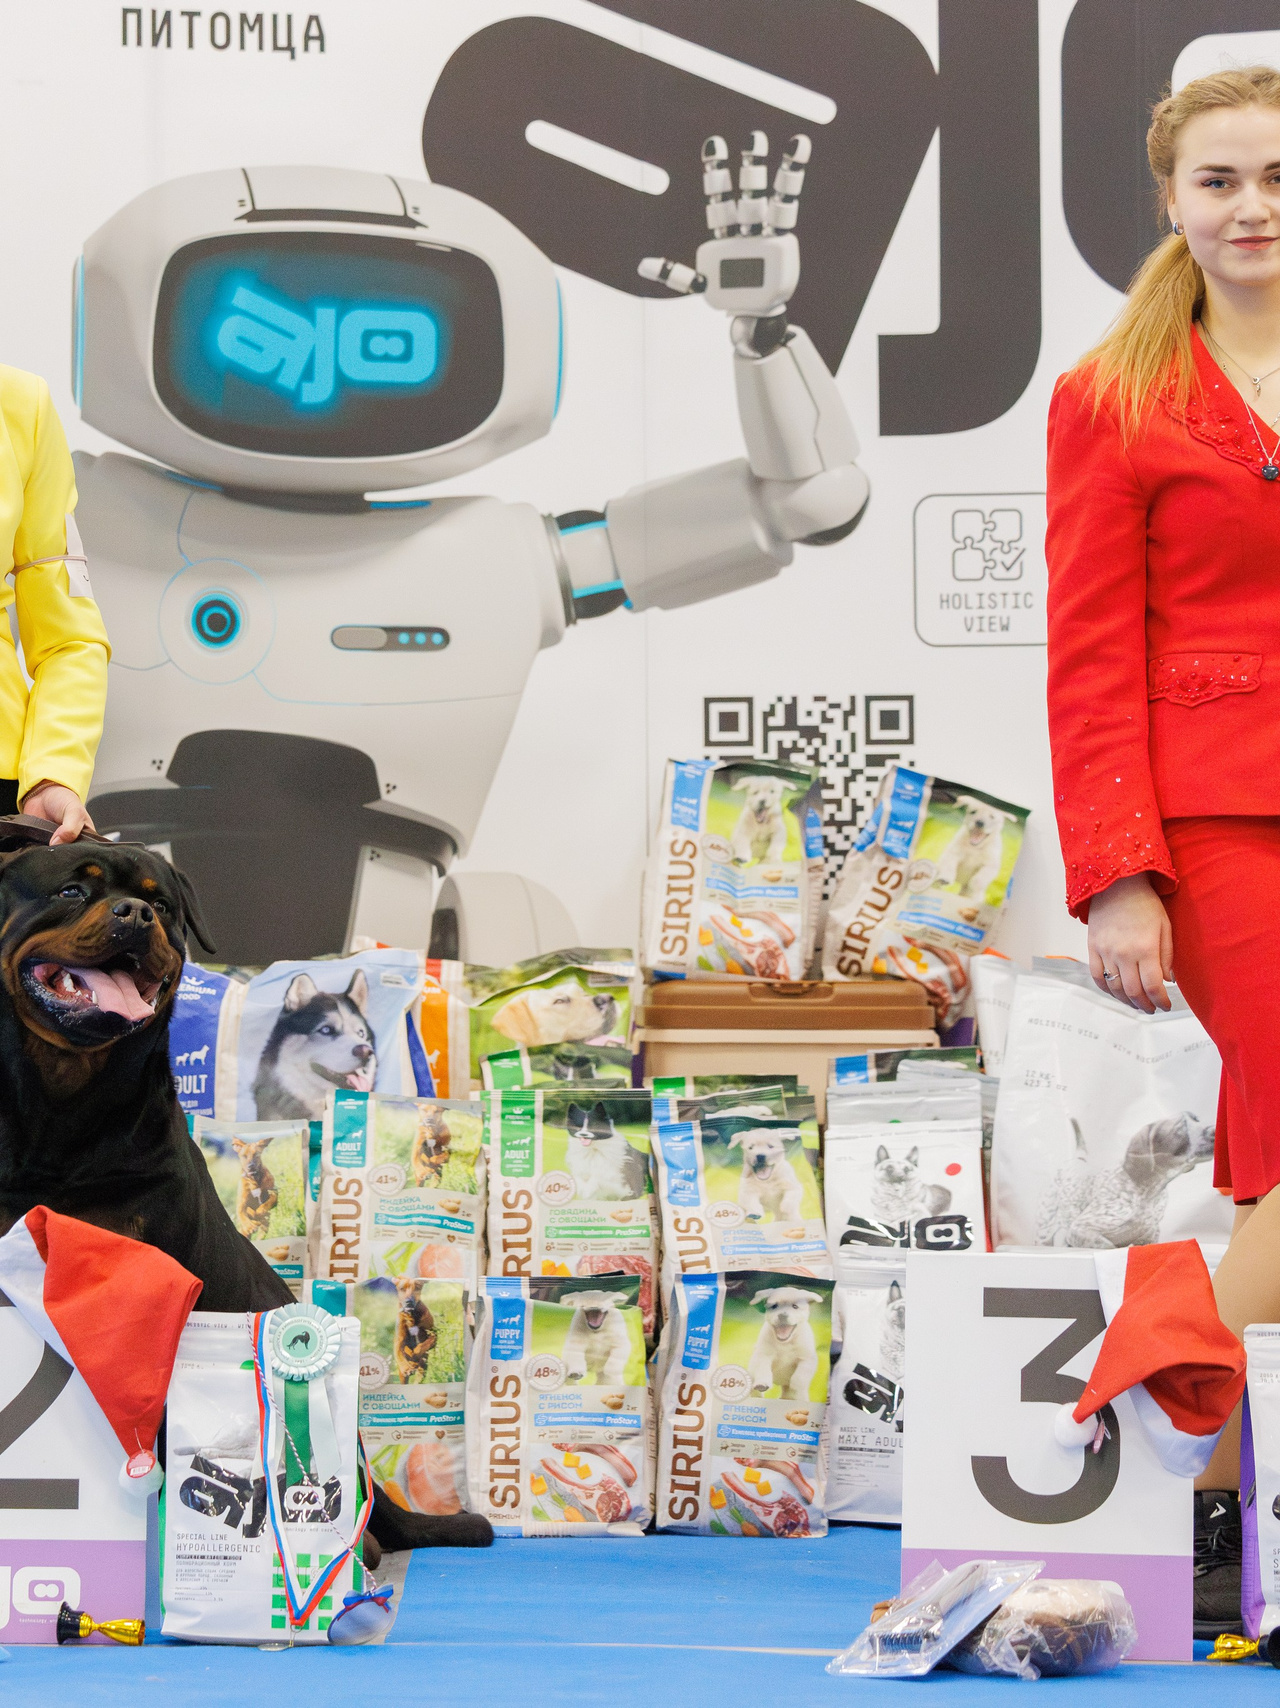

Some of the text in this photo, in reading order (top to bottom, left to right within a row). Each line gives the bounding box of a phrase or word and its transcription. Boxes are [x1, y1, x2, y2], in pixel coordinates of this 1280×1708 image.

[121, 7, 326, 60] ПИТОМЦА
[939, 592, 1034, 610] HOLISTIC
[964, 616, 1010, 633] VIEW
[659, 838, 698, 957] SIRIUS
[835, 866, 904, 977] SIRIUS
[1027, 1016, 1072, 1032] HOLISTIC
[335, 1142, 362, 1152] ADULT
[504, 1149, 530, 1160] ADULT
[376, 1174, 398, 1184] 41%
[545, 1182, 570, 1194] 40%
[549, 1208, 598, 1216] ГОВЯДИНА
[714, 1209, 739, 1218] 48%
[558, 1216, 607, 1224] ОВОЩАМИ
[329, 1176, 363, 1283] IRIUS
[494, 1328, 521, 1340] PUPPY
[687, 1336, 709, 1349] PUPPY
[534, 1366, 560, 1378] 48%
[719, 1377, 745, 1389] 48%
[362, 1392, 406, 1402] ИНДЕЙКА
[538, 1393, 583, 1401] ЯГНЕНОК
[371, 1402, 421, 1411] ОВОЩАМИ
[547, 1402, 583, 1410] РИСОМ
[723, 1404, 767, 1414] ЯГНЕНОК
[970, 1286, 1121, 1525] 3
[732, 1413, 767, 1424] РИСОМ
[489, 1374, 521, 1509] SIRIUS
[837, 1434, 866, 1445] MAXI
[668, 1382, 707, 1522] SIRIUS
[488, 1512, 521, 1520] PREMIUM
[176, 1532, 228, 1541] SPECIAL LINE
[176, 1543, 261, 1553] HYPOALLERGENIC
